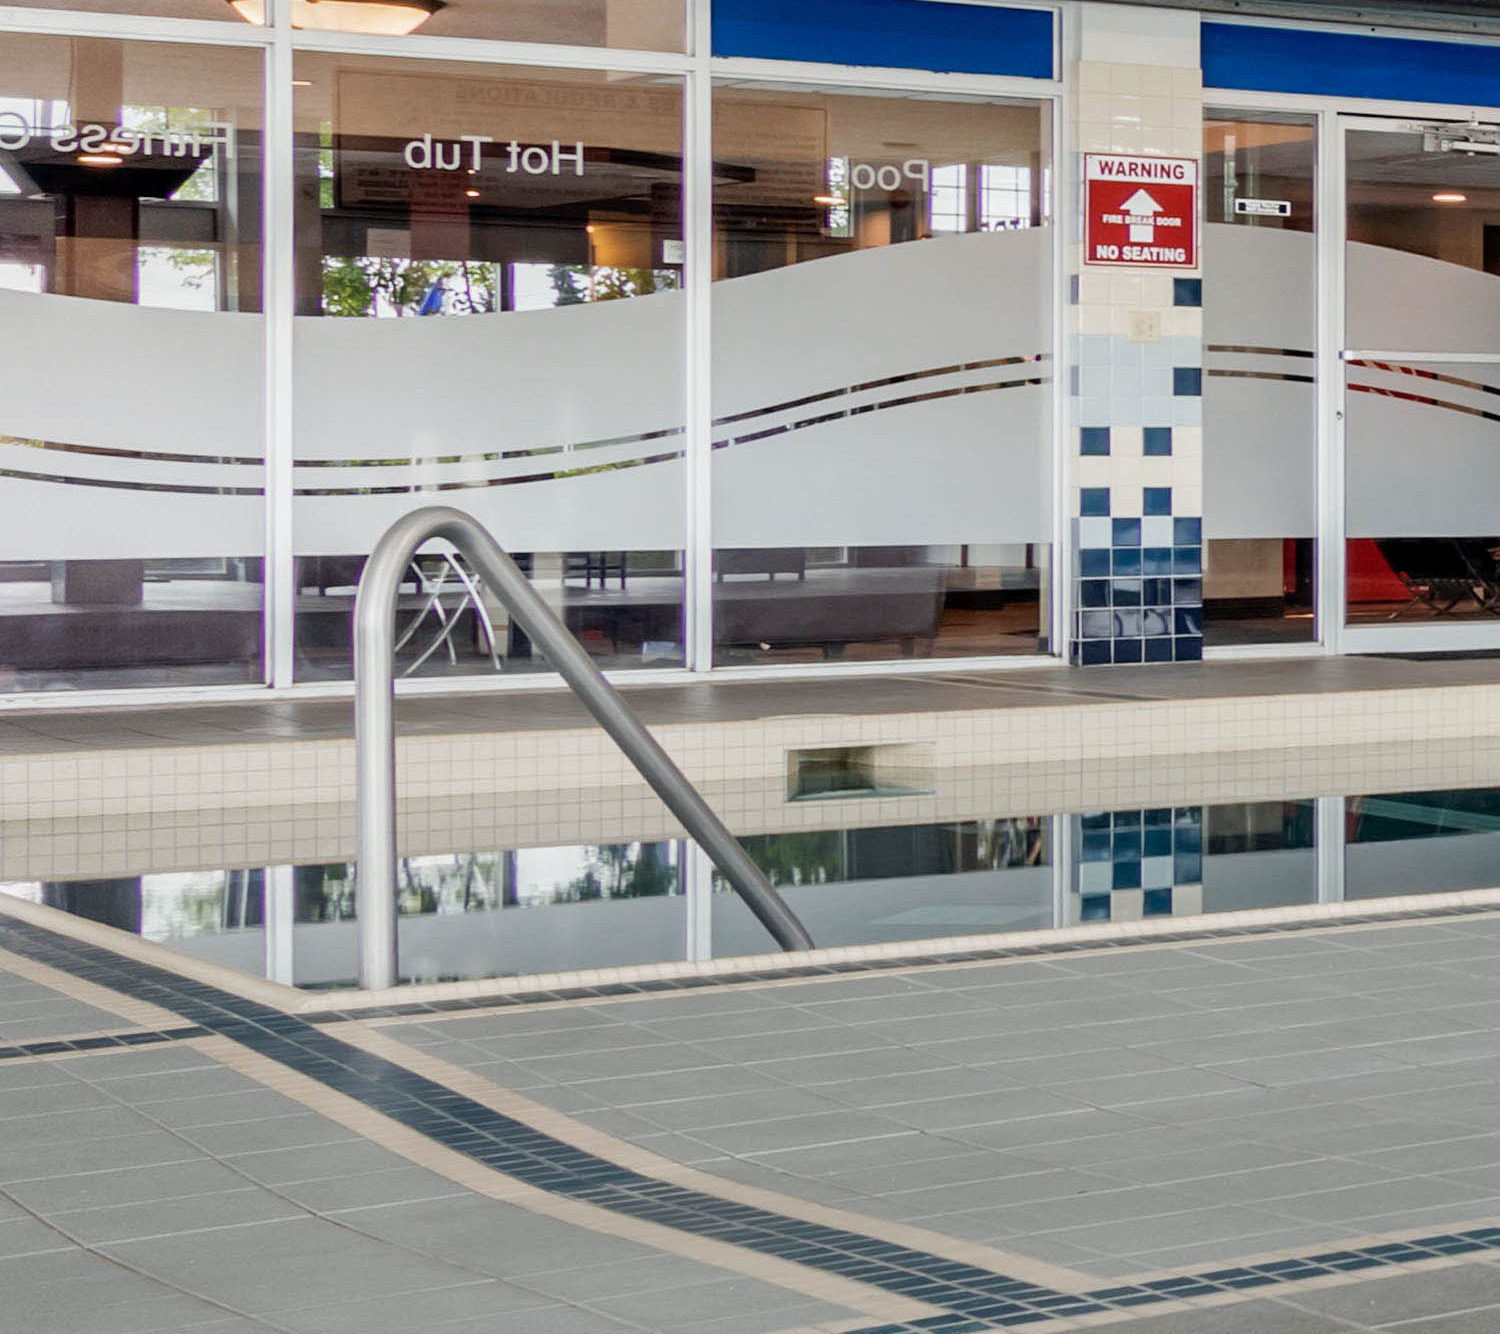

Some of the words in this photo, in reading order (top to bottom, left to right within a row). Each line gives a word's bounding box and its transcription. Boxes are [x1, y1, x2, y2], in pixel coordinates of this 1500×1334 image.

[1098, 160, 1185, 179] WARNING
[1102, 213, 1123, 225] FIRE
[1156, 216, 1182, 227] DOOR
[1096, 244, 1119, 260] NO
[1122, 245, 1186, 263] SEATING
